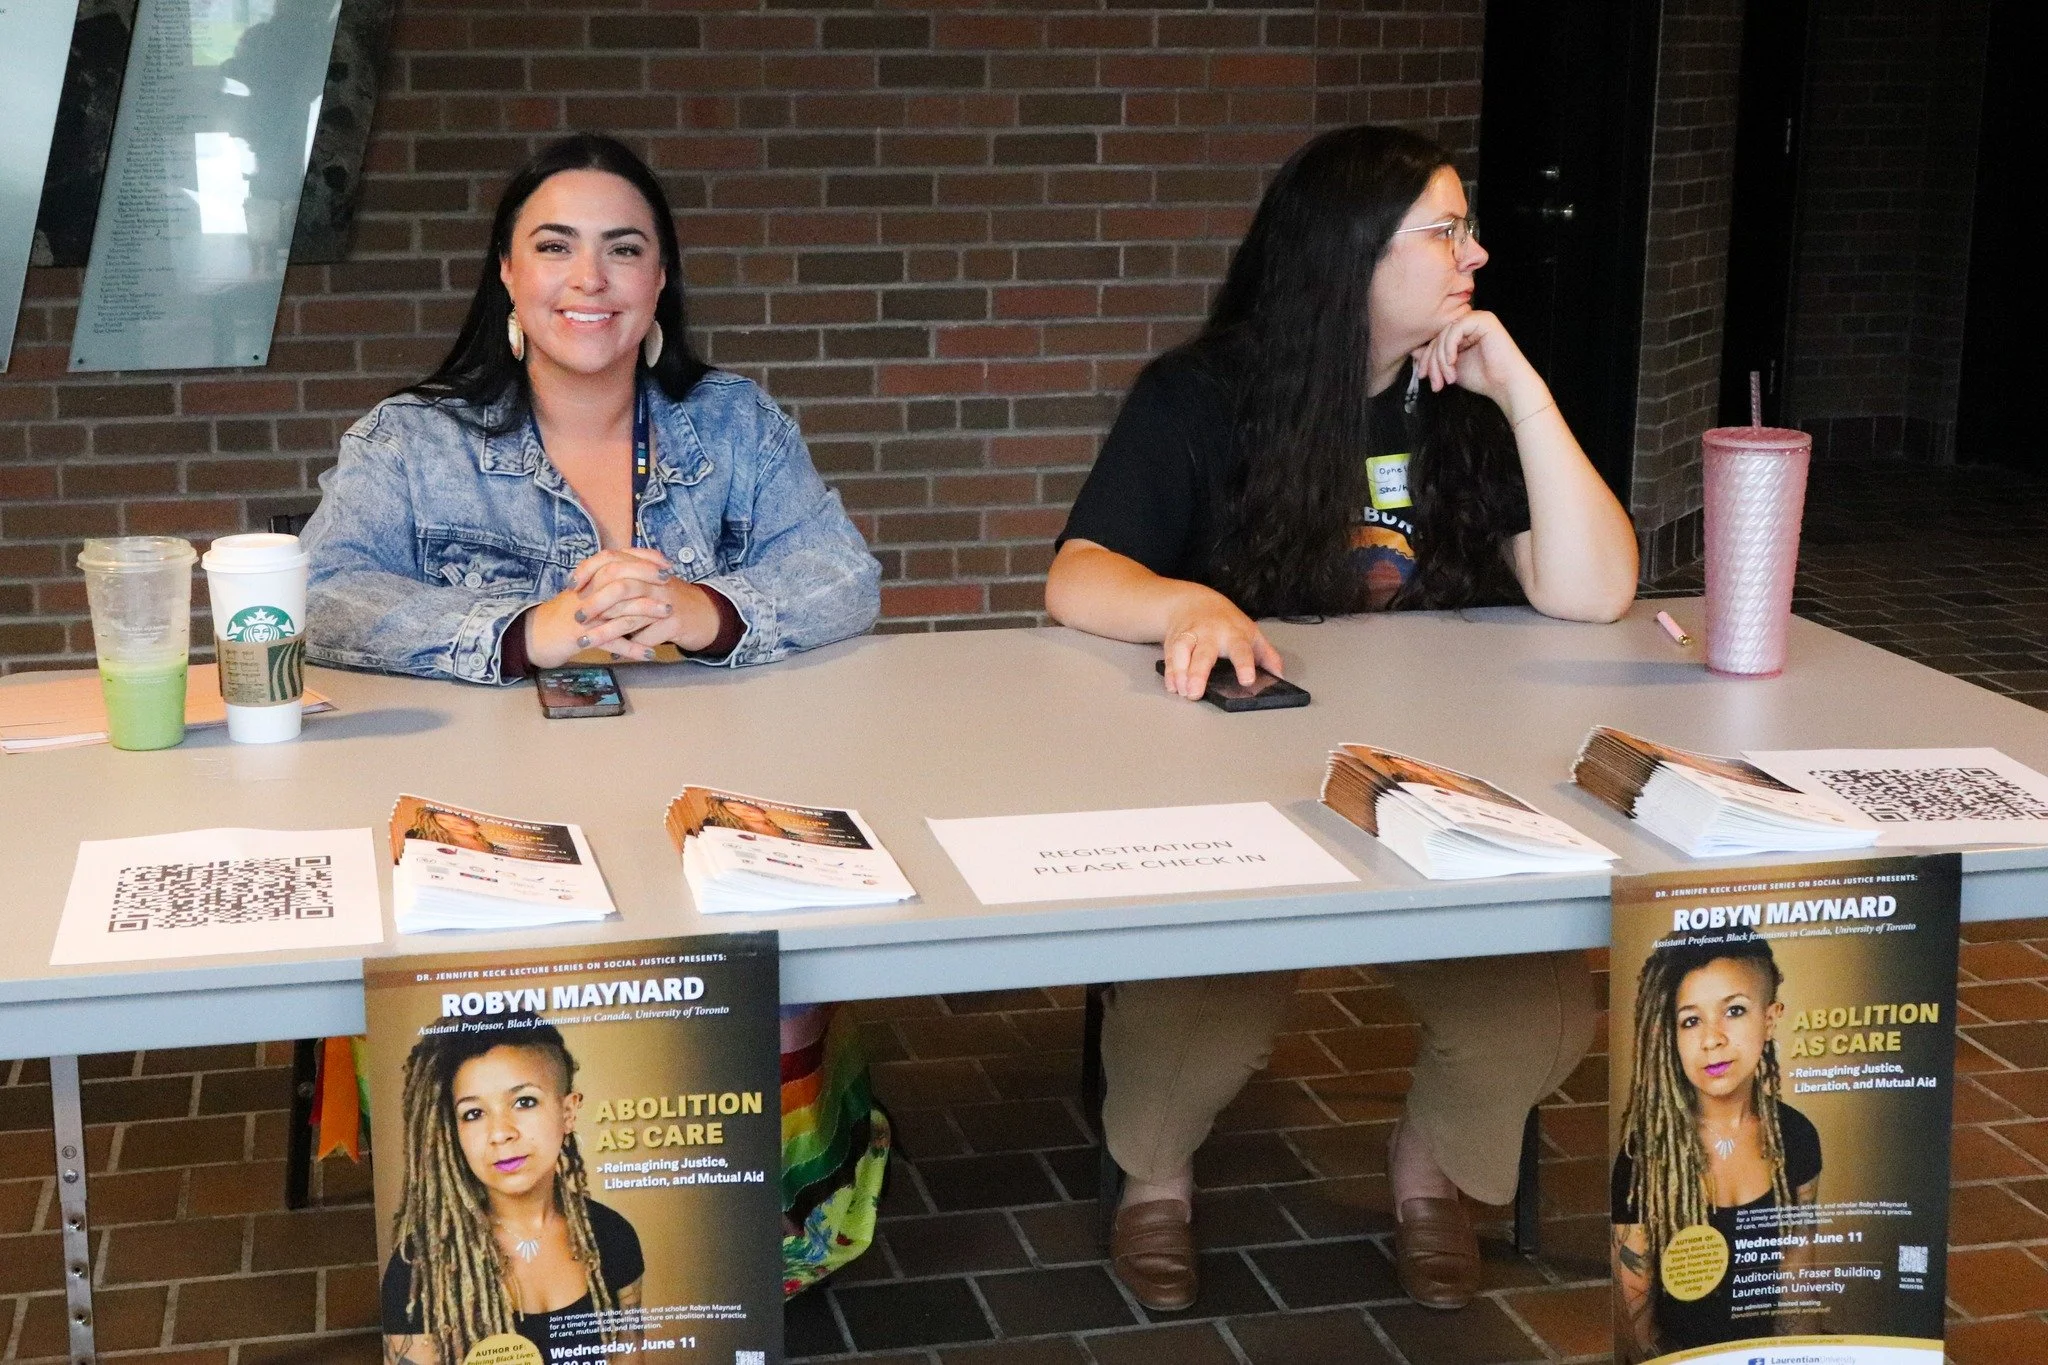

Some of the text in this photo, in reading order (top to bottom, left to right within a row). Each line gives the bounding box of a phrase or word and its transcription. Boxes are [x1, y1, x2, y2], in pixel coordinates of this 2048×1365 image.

[1039, 840, 1233, 859] REGISTRATION
[1033, 854, 1267, 875] PLEASE CHECK IN
[1655, 890, 1668, 898] DR.
[1671, 887, 1708, 897] JENNIFER
[1710, 886, 1730, 894] KECK
[1733, 883, 1767, 893] LECTURE
[1769, 881, 1796, 890] SERIES
[1812, 879, 1841, 887] SOCIAL
[1843, 876, 1874, 885] JUSTICE
[1876, 874, 1918, 883] PRESENTS:
[1673, 895, 1897, 931] ROBYN MAYNARD
[1652, 938, 1686, 949] Assistant
[1688, 936, 1724, 946] Professor,
[1726, 933, 1748, 942] Black
[1749, 931, 1788, 942] feminisms
[1799, 928, 1832, 937] Canada,
[1834, 924, 1874, 935] University
[1875, 923, 1885, 934] of
[1885, 923, 1916, 931] Toronto
[416, 953, 727, 982] DR. JENNIFER KECK LECTURE SERIES ON SOCIAL JUSTICE PRESENTS:
[442, 977, 705, 1017] ROBYN MAYNARD
[417, 1006, 730, 1036] Assistant Professor, Black feminisms in Canada, University of Toronto
[1793, 1003, 1939, 1031] ABOLITION
[1791, 1031, 1902, 1058] AS CARE
[1795, 1063, 1904, 1078] Reimagining Justice,
[1794, 1077, 1937, 1094] Liberation, and Mutual Aid
[595, 1092, 762, 1122] ABOLITION
[596, 1122, 724, 1151] AS CARE
[604, 1156, 729, 1174] Reimagining Justice,
[604, 1171, 764, 1190] Liberation, and Mutual Aid
[1735, 1234, 1809, 1250] Wednesday,
[1812, 1233, 1844, 1245] June
[1848, 1232, 1863, 1243] 11
[1734, 1251, 1785, 1264] 7:00 p.m.
[1733, 1267, 1882, 1284] Auditorium, Fraser Building
[1732, 1281, 1845, 1299] Laurentian University
[564, 1311, 598, 1320] renowned
[600, 1309, 623, 1317] author,
[689, 1304, 711, 1312] Robyn
[711, 1303, 742, 1312] Maynard
[549, 1323, 559, 1331] for
[567, 1320, 588, 1329] timely
[588, 1318, 601, 1326] and
[602, 1315, 640, 1325] compelling
[675, 1312, 705, 1320] abolition
[720, 1312, 747, 1320] practice
[549, 1331, 557, 1339] of
[575, 1327, 600, 1335] mutual
[615, 1324, 628, 1332] and
[475, 1346, 510, 1357] AUTHOR
[550, 1337, 696, 1359] Wednesday, June 11
[496, 1355, 514, 1363] Black
